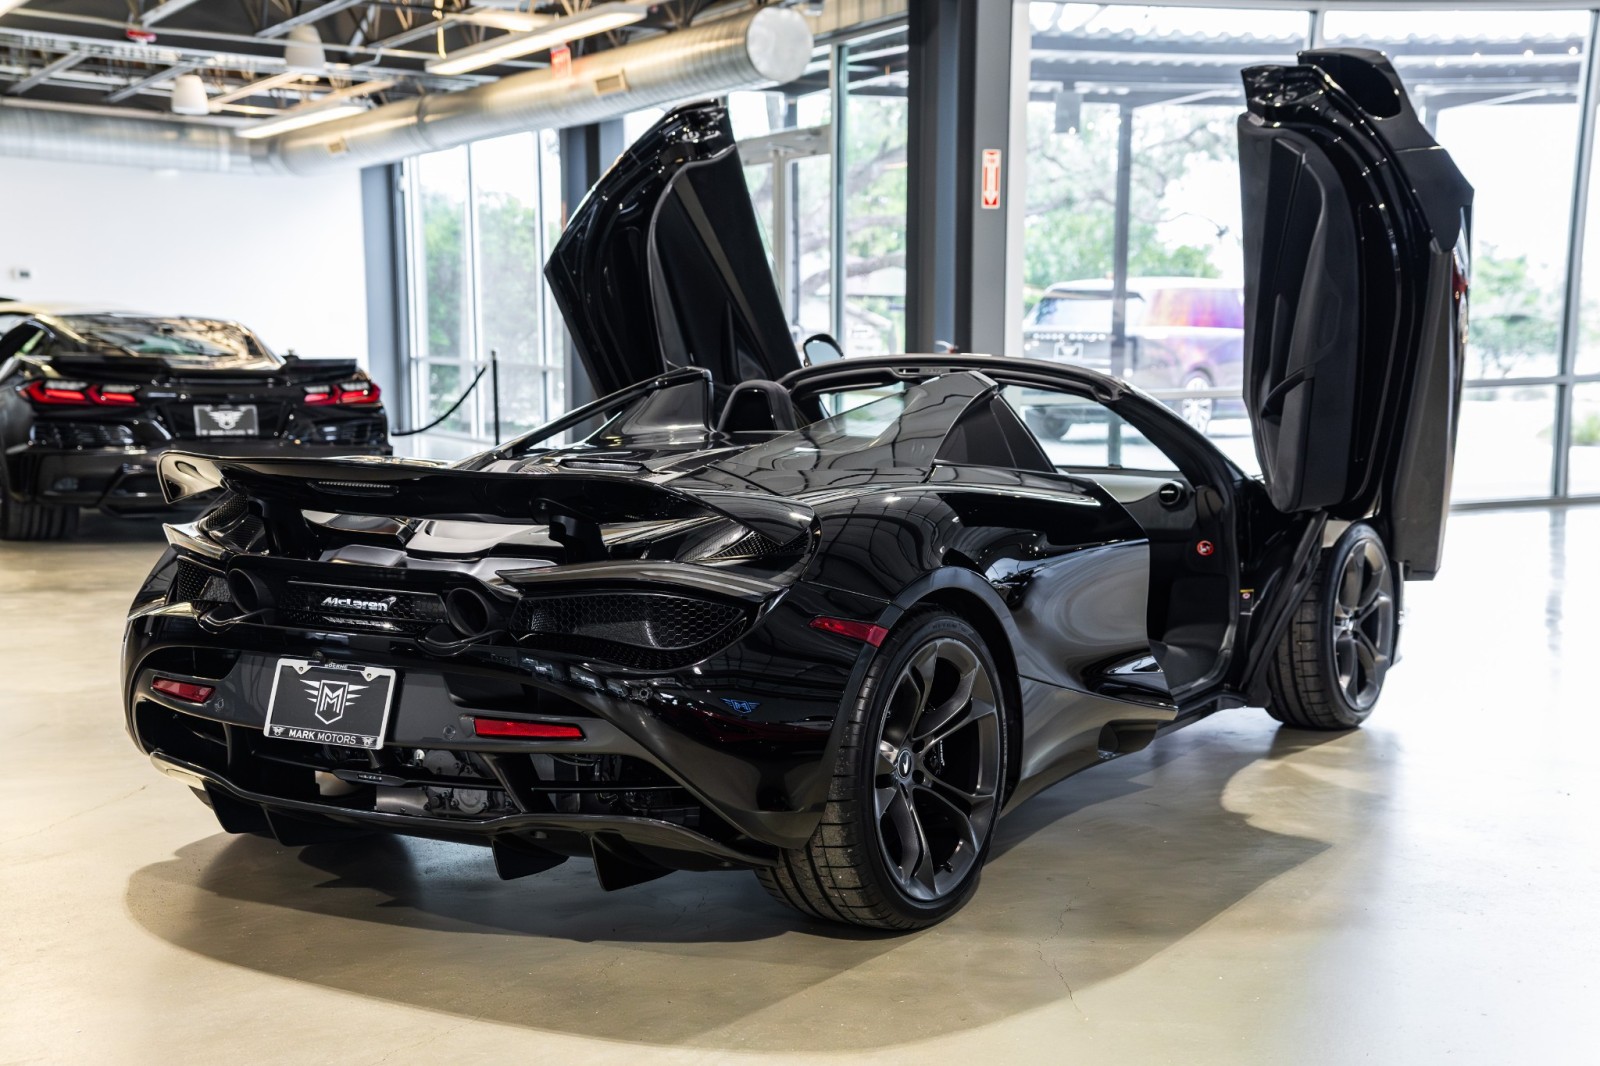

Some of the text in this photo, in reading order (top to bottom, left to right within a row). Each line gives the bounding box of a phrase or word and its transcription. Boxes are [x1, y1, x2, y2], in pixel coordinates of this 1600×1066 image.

[321, 596, 389, 612] McLaren
[288, 728, 357, 745] MARK MOTORS
